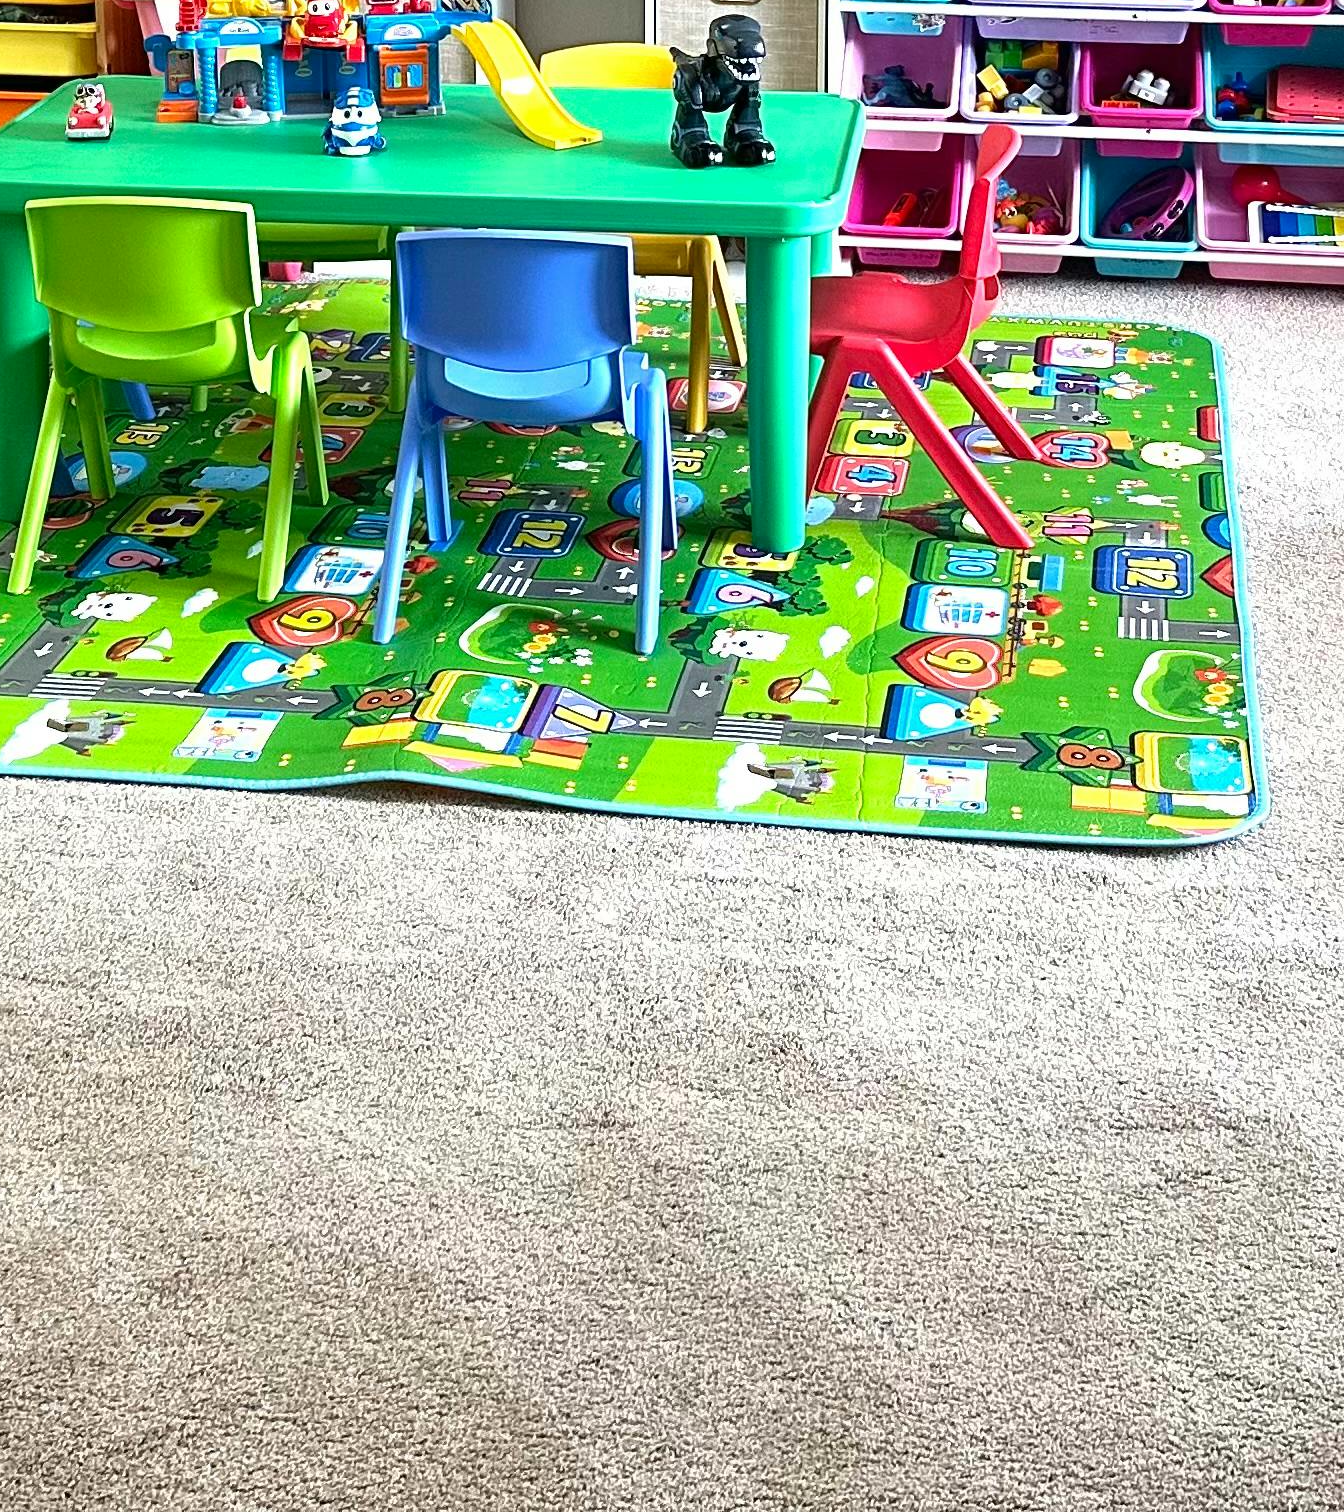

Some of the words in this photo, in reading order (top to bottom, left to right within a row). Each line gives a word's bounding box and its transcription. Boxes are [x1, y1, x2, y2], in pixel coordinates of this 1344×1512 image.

[513, 518, 569, 553] 12
[1126, 556, 1180, 590] 12
[353, 687, 417, 713] 8
[1056, 744, 1126, 771] 8
